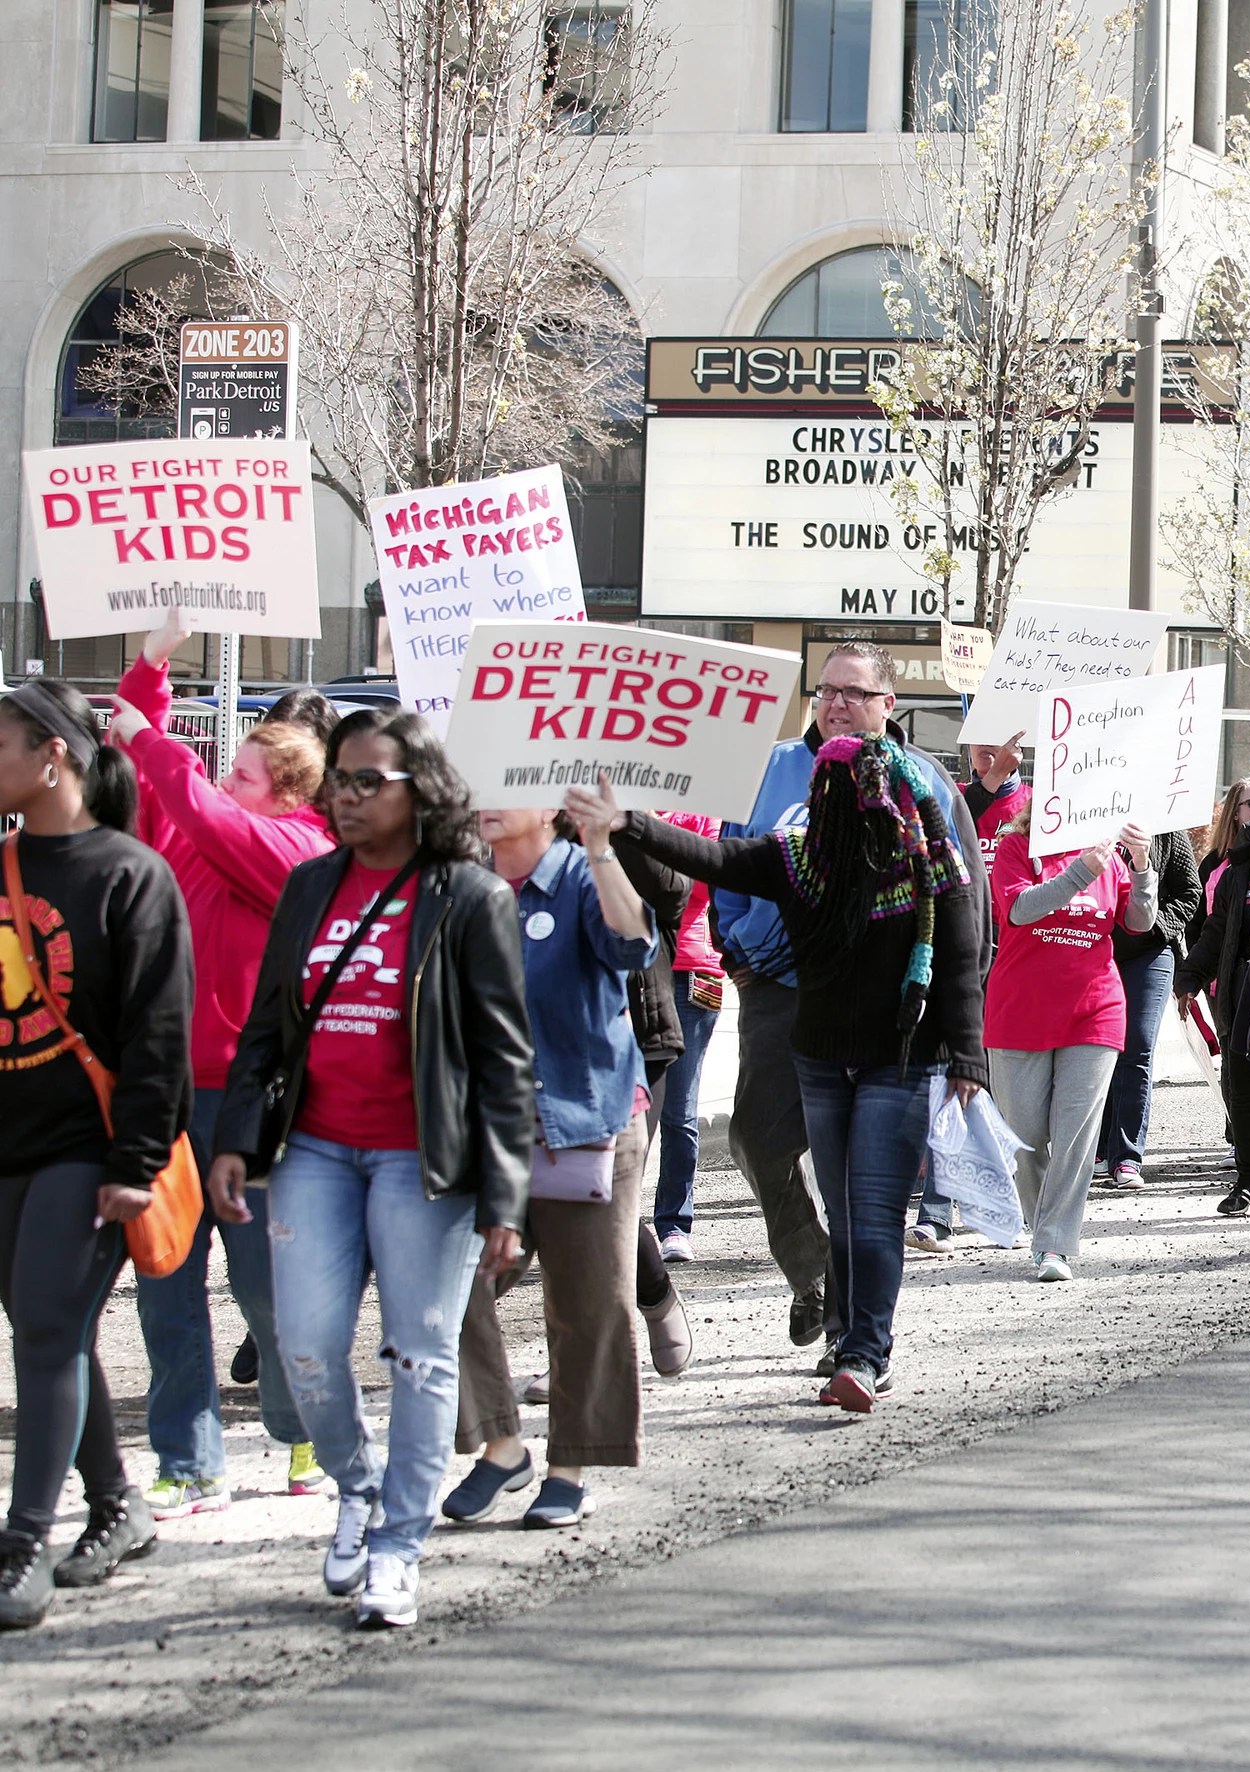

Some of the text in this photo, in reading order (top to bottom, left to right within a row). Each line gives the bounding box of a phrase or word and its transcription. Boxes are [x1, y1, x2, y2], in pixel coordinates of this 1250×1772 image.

[185, 329, 285, 358] ZONE 203
[191, 371, 279, 380] SIGN UP FOR MOBILE PAY
[692, 347, 905, 389] FISHER
[259, 401, 281, 412] .US
[49, 459, 289, 486] OUR FIGHT FOR
[766, 459, 918, 487] BROADWAY
[41, 483, 304, 530] DETROIT
[113, 525, 252, 564] KIDS
[384, 516, 564, 570] TAX PAYERS
[731, 522, 1031, 552] THE SOUND OF MUSC
[398, 563, 524, 598] want to
[107, 581, 267, 617] www.ForDetroitKids.org
[403, 586, 573, 625] know where
[841, 588, 897, 614] MAY
[911, 589, 938, 615] 10
[970, 634, 984, 643] YOU
[1015, 617, 1150, 650] What about our
[492, 641, 770, 688] OUR FIGHT FOR
[1045, 653, 1076, 682] They
[1080, 661, 1110, 678] need
[1114, 664, 1132, 677] to
[470, 665, 779, 725] DETROIT
[993, 677, 1017, 691] eat
[528, 705, 693, 748] KIDS
[1051, 697, 1144, 741] Deception
[1052, 743, 1127, 792] Politics
[1040, 791, 1132, 834] Shameful
[978, 838, 999, 851] DF
[326, 919, 392, 943] DT
[1032, 927, 1062, 936] DETOIT
[1042, 935, 1092, 949] OF TEACHERS
[325, 1019, 378, 1036] TEACHERS
